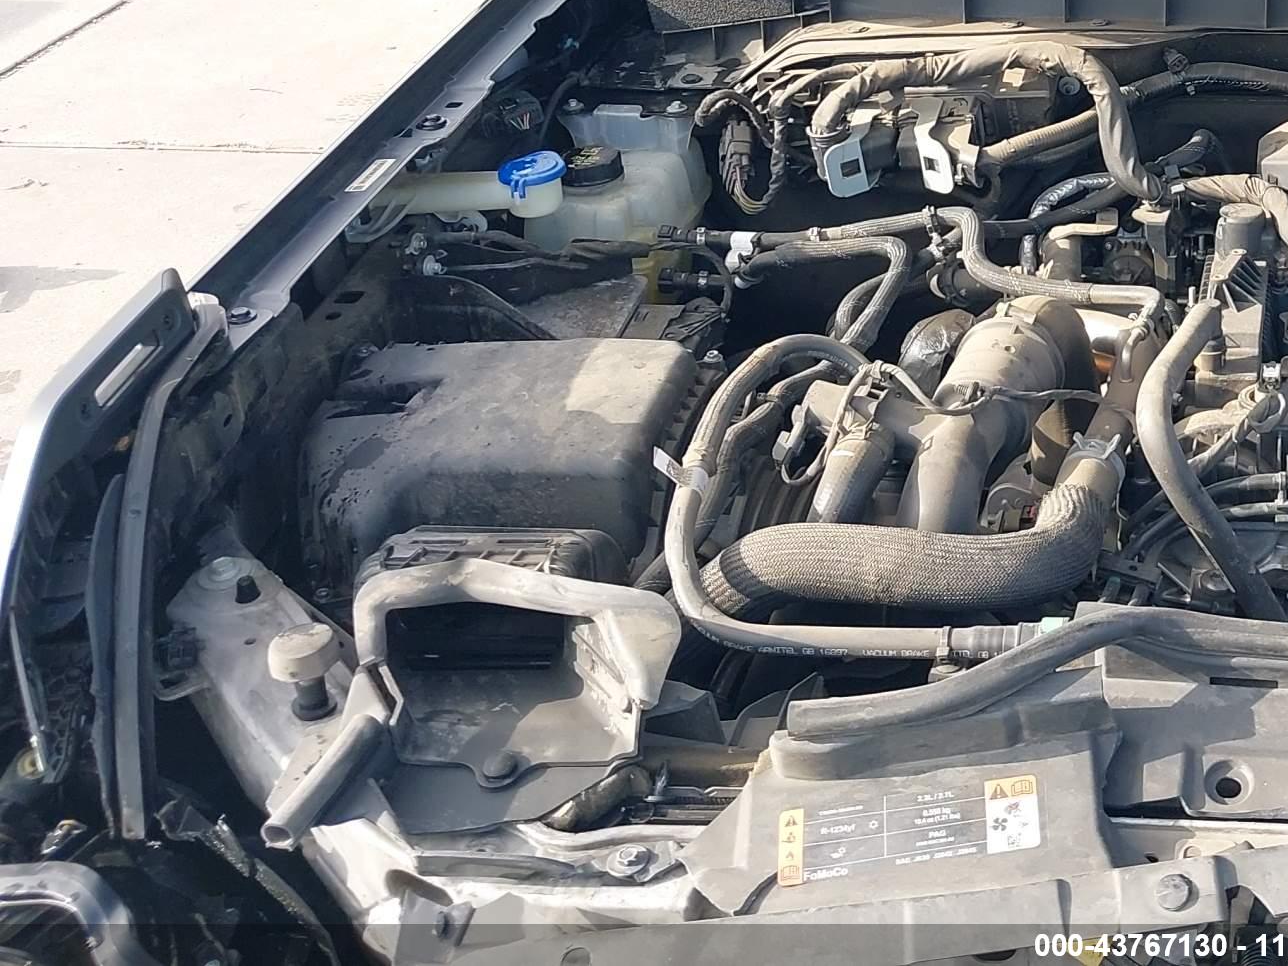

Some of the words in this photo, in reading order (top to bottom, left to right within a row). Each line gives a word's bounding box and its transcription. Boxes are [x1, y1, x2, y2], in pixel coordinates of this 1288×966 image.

[862, 649, 898, 657] VACUUM
[901, 649, 931, 658] BRAKE
[803, 867, 849, 882] FoMoCo
